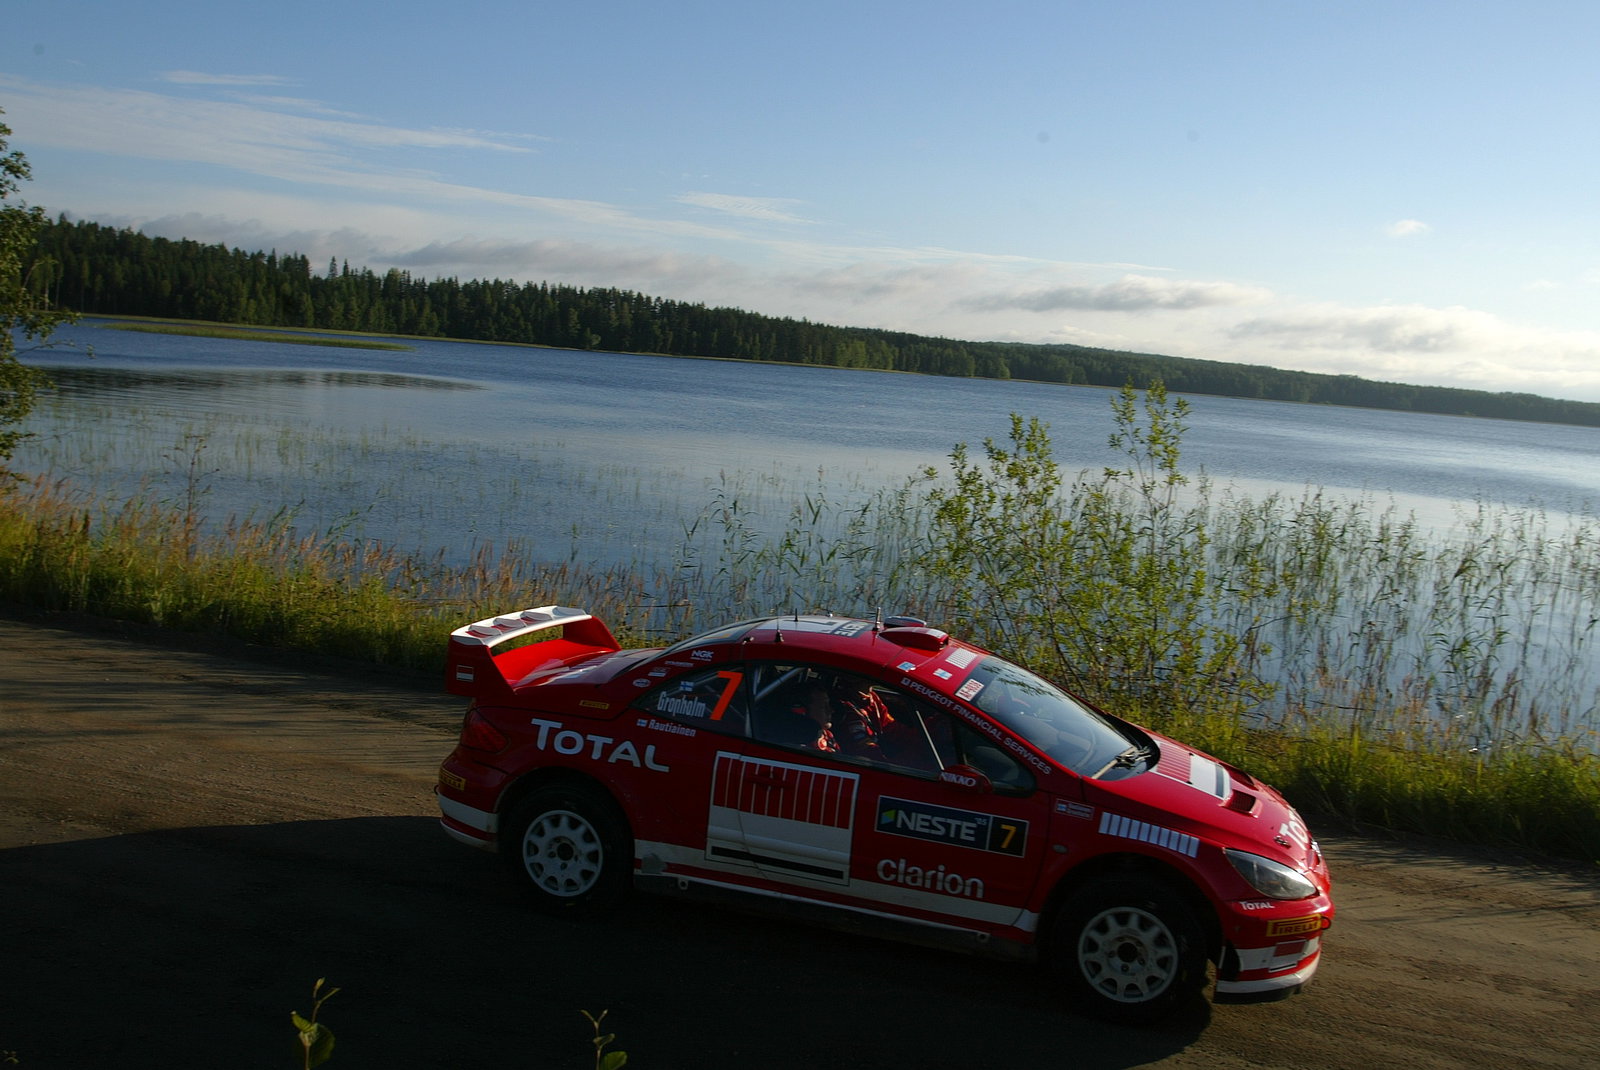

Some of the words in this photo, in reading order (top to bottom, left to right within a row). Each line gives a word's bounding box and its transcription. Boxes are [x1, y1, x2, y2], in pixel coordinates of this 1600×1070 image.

[691, 650, 713, 659] NGK
[709, 670, 744, 721] 7
[909, 681, 954, 708] PEUGEOT
[953, 704, 1002, 740] FINANCIAL
[1003, 736, 1052, 775] SERVICES
[531, 718, 670, 773] TOTAL
[939, 771, 976, 787] NIKKO
[896, 809, 977, 842] NESTE
[999, 824, 1017, 849] 7
[876, 858, 985, 899] Clarion
[1239, 901, 1276, 911] TOTAL
